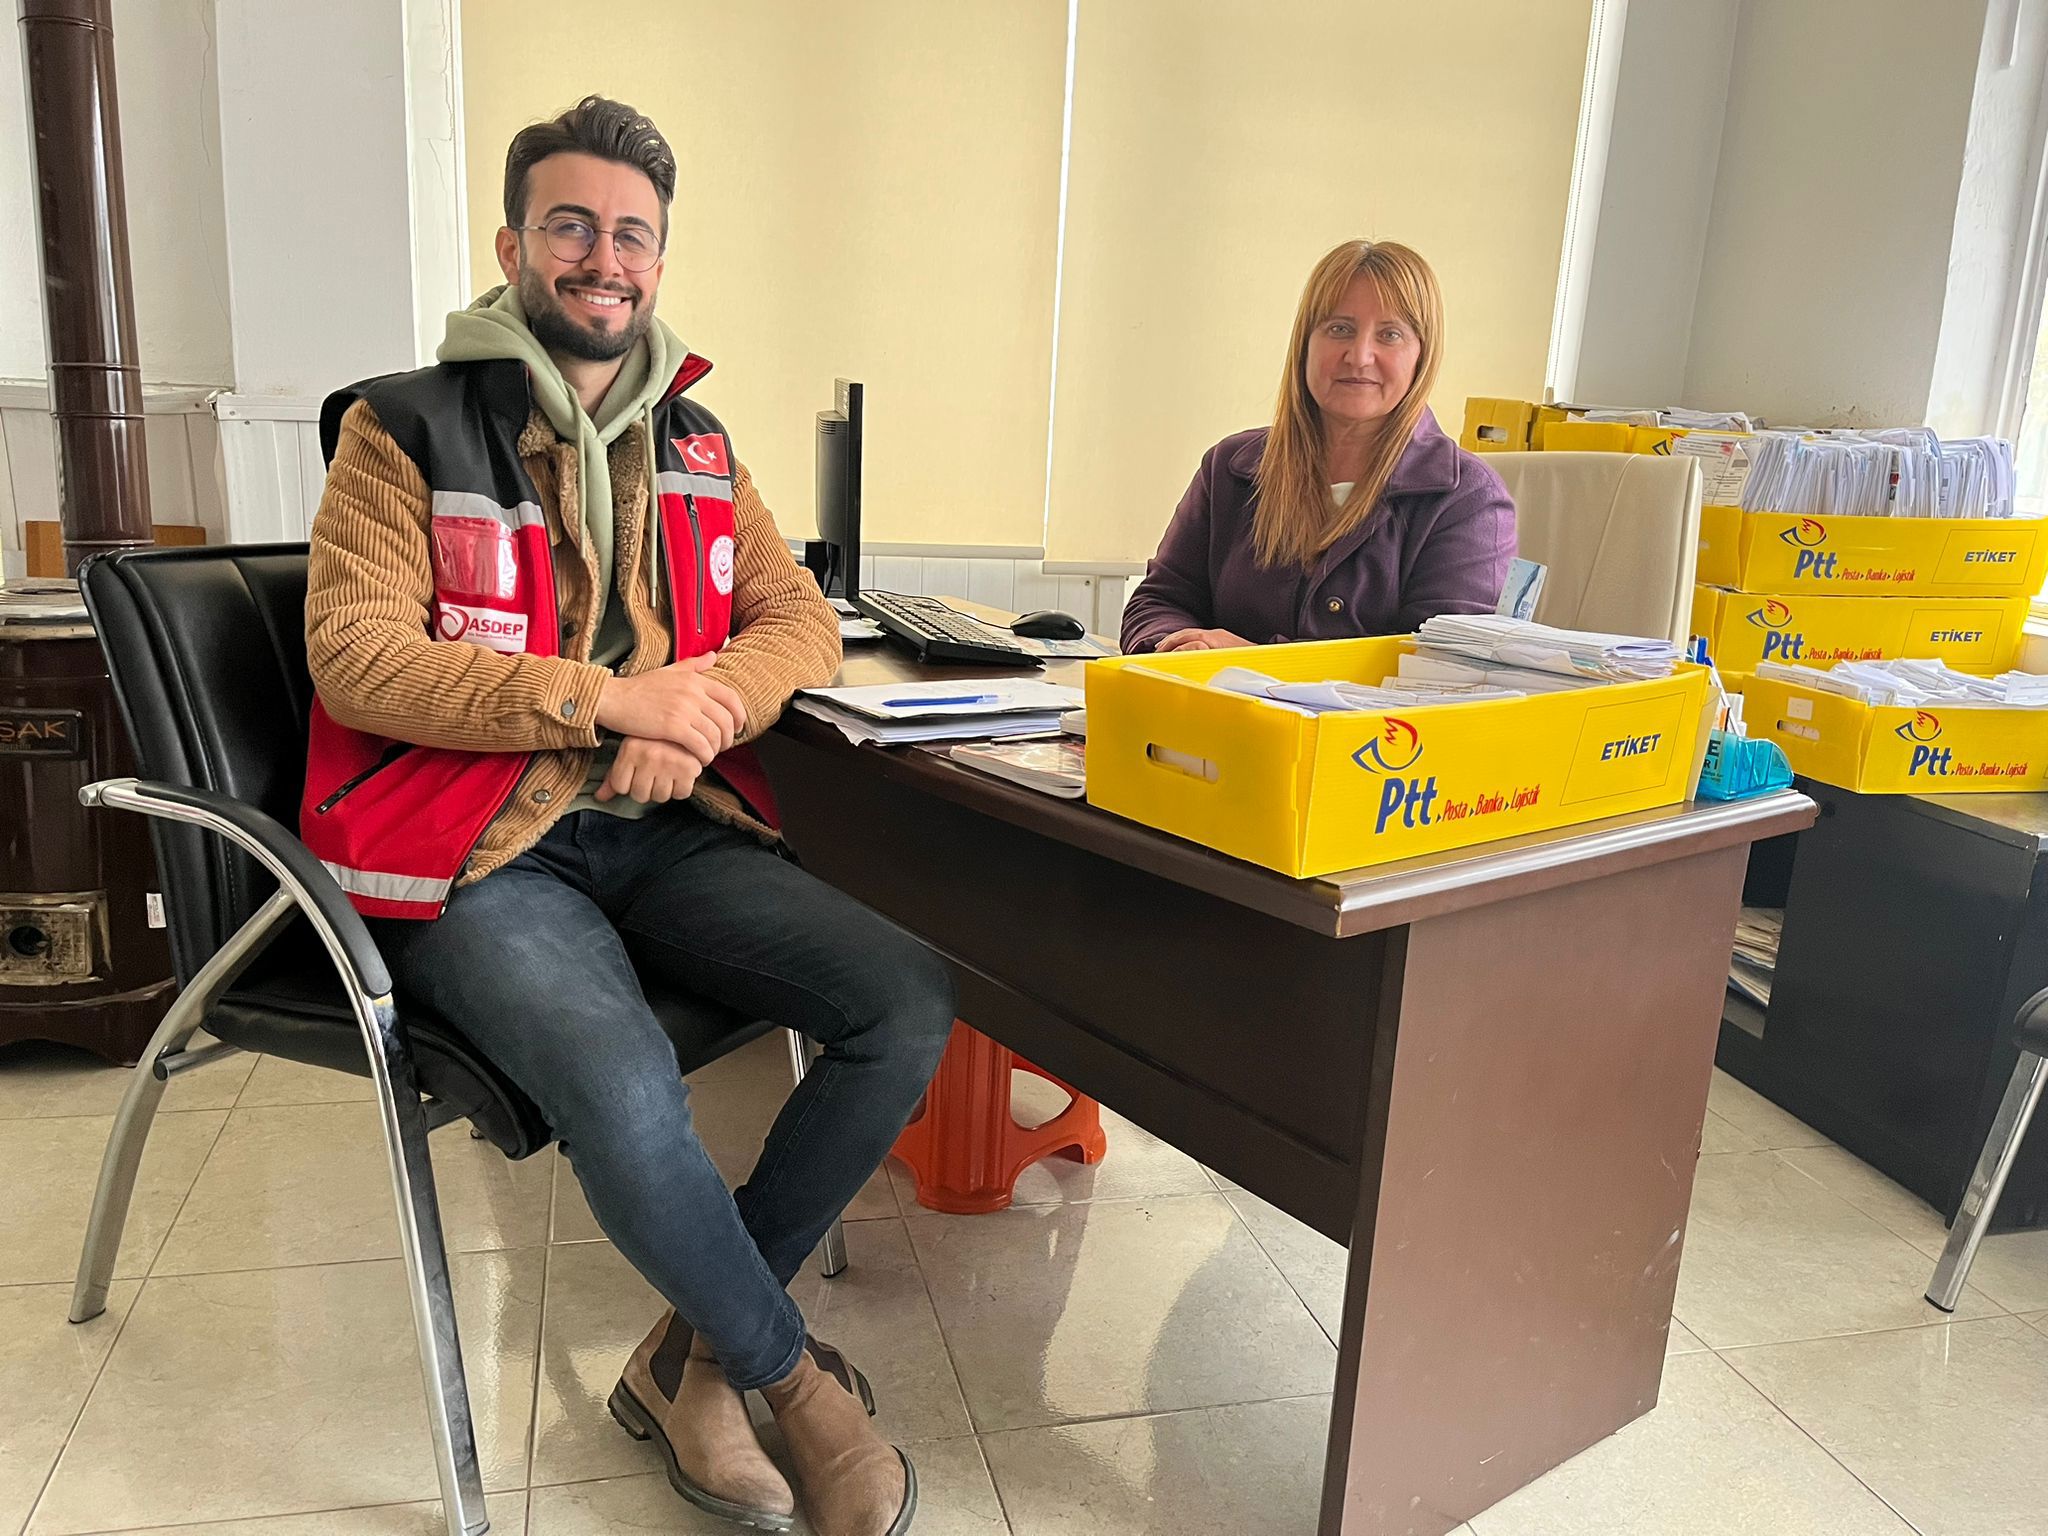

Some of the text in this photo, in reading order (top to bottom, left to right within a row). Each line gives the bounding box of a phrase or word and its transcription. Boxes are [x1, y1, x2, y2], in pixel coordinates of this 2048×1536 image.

[1793, 550, 1916, 583] Ptt Posta Banka Lojistik
[1964, 550, 2017, 562] ETİKET
[468, 618, 524, 635] ASDEP
[1930, 629, 1983, 642] ETİKET
[1762, 631, 1804, 660] Ptt
[1809, 647, 1827, 660] Posta
[1833, 647, 1854, 660] Banka
[1600, 734, 1662, 761] ETİKET
[1908, 745, 2028, 777] Ptt Posta Banka Lojistik
[1374, 776, 1541, 834] Ptt Posta Banka Lojistik
